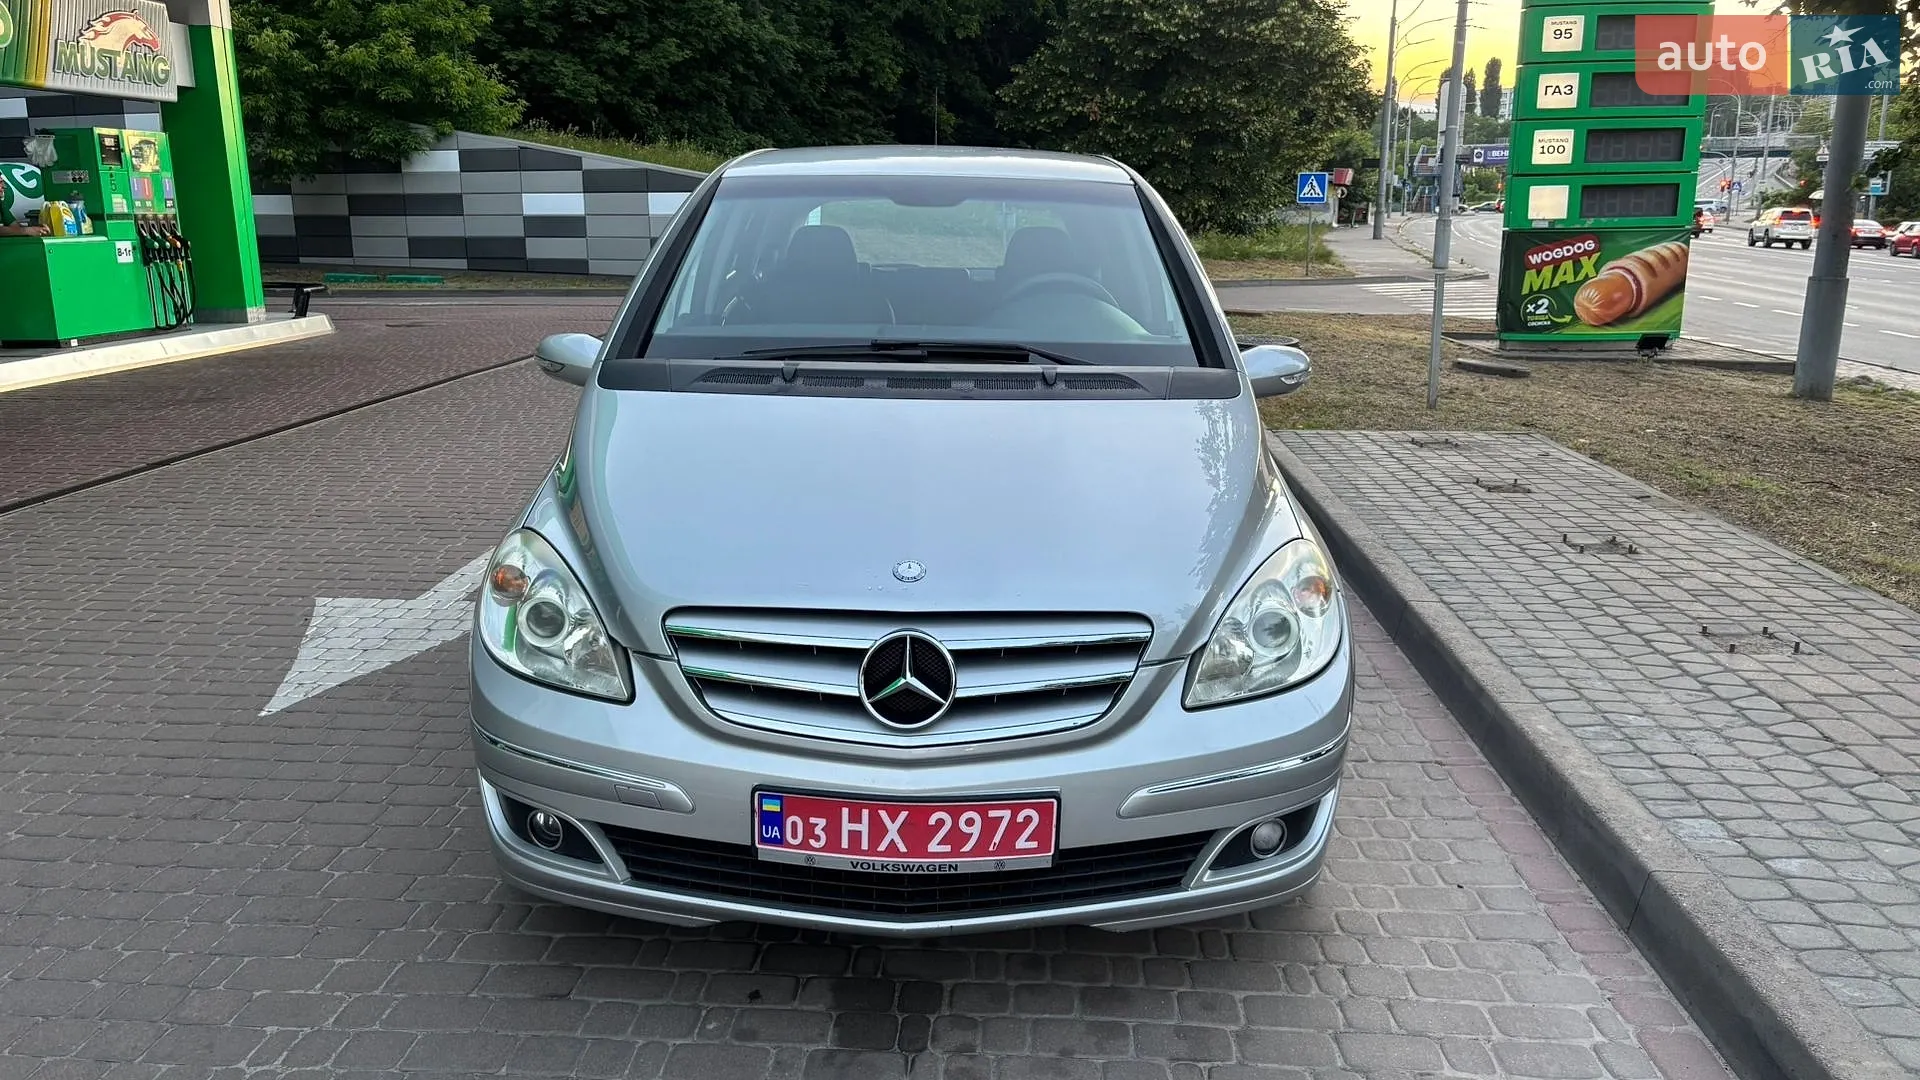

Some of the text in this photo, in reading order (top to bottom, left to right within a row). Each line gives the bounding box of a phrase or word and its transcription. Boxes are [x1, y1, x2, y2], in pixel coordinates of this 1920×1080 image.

[1553, 28, 1573, 40] 95
[55, 40, 171, 86] MUSTANG
[1544, 84, 1574, 96] ГАЗ
[1539, 144, 1566, 155] 100
[1528, 240, 1595, 265] WOGDOG
[1521, 252, 1601, 295] MAX
[762, 825, 781, 839] UA
[785, 807, 1040, 853] 03 HX 2972
[850, 861, 959, 873] VOLKSWAGEN
